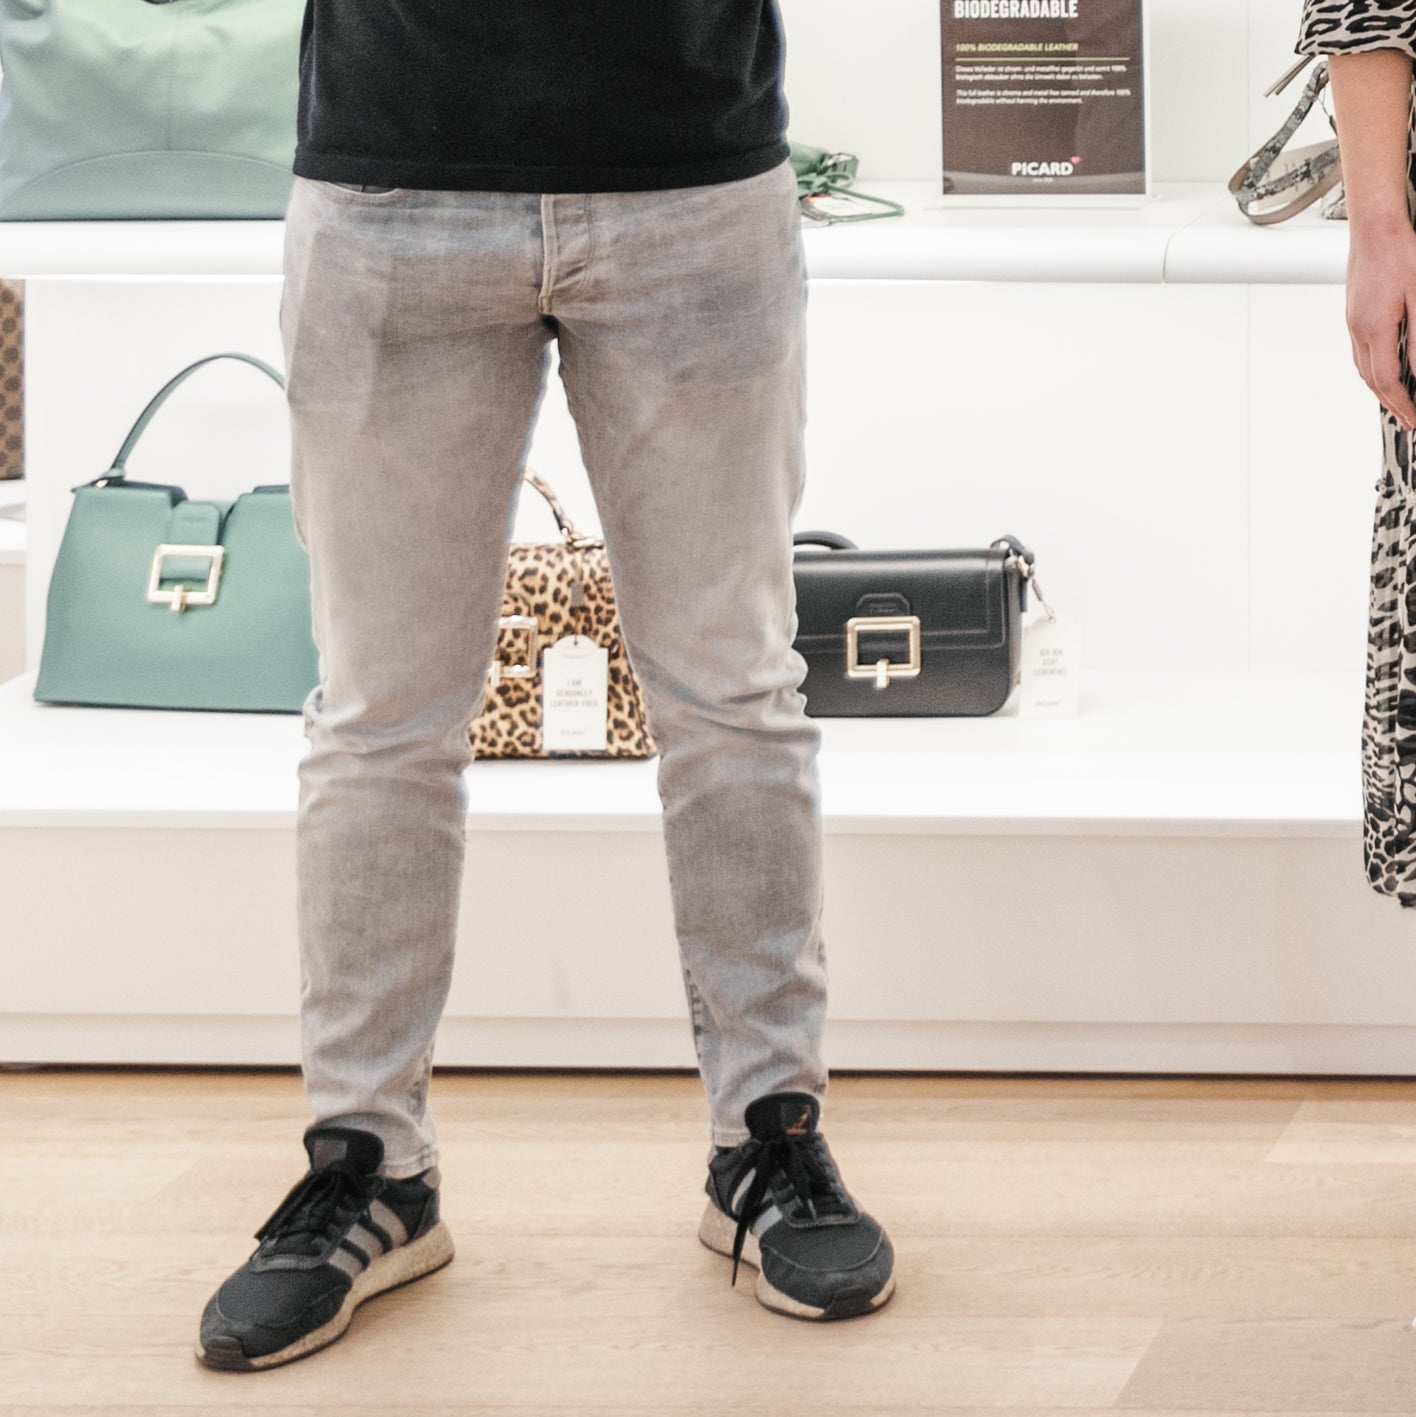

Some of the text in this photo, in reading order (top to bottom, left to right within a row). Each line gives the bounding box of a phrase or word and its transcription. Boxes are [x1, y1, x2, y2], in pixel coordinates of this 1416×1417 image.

[977, 42, 1044, 52] BIODEGRADABLE
[1044, 42, 1079, 52] LEATHER
[1011, 161, 1074, 176] PICARD
